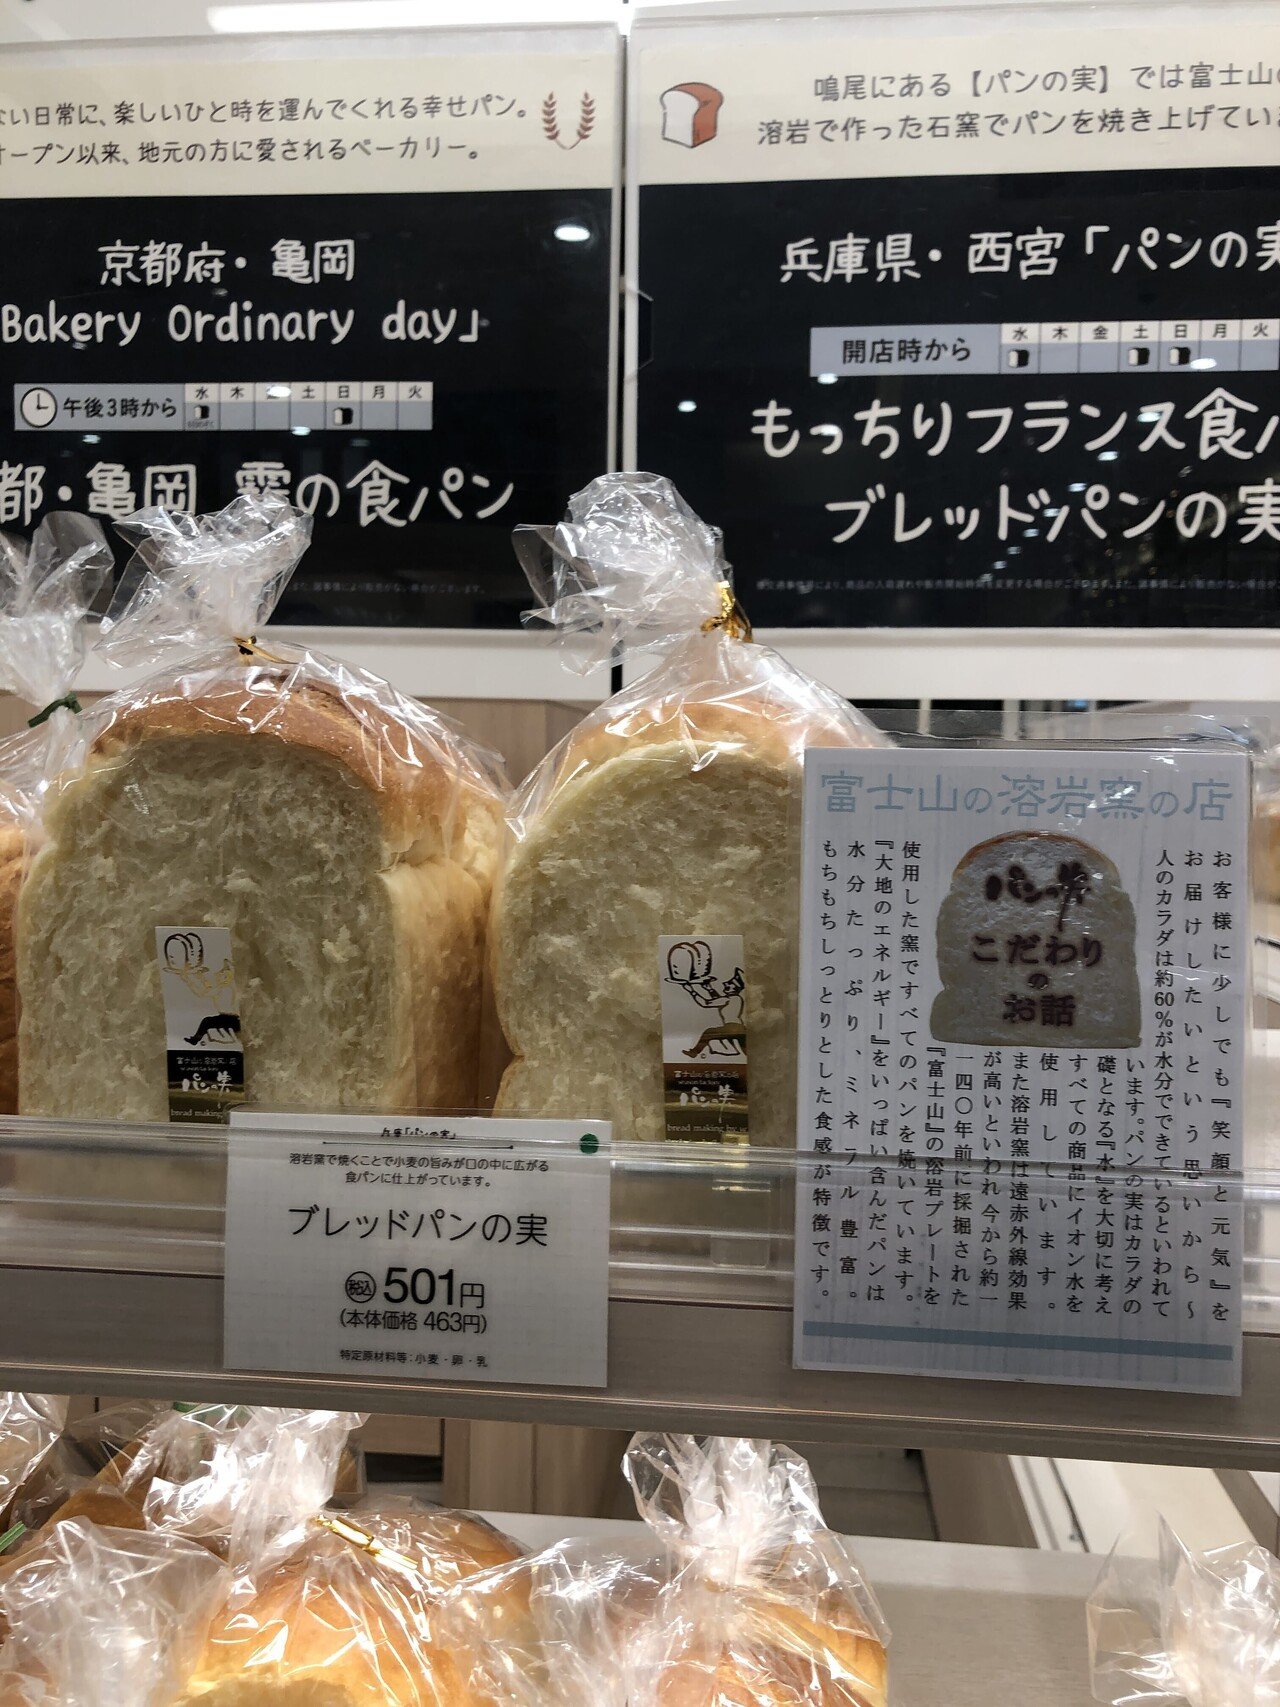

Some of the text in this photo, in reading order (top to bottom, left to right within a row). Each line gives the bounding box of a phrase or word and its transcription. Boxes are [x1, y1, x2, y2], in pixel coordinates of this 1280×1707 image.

[814, 62, 1280, 103] 鳴尾にある【パンの実】では富士山
[758, 104, 1280, 147] 溶岩で作った石窯でパンを焼き上げてい
[1, 302, 141, 347] Bakery
[168, 301, 355, 344] Ordinary
[1013, 324, 1269, 341] 水 木 金 土 日 月 火
[842, 337, 972, 364] 開店時から
[62, 397, 178, 419] 午後3時から
[194, 387, 210, 399] 水
[230, 386, 245, 399] 木
[301, 386, 316, 399] 土
[338, 386, 350, 399] 日
[372, 386, 386, 399] 月
[408, 386, 423, 399] 火
[821, 770, 1233, 821] 富士山の溶岩窯の店
[972, 934, 1103, 967] こだわり
[1028, 973, 1049, 990] の
[1003, 994, 1076, 1027] お話
[667, 1124, 691, 1132] bread
[345, 1171, 492, 1188] 食パンに仕上がっています。
[1037, 1053, 1060, 1311] 使用しています。
[288, 1204, 548, 1247] ブレッドパンの実
